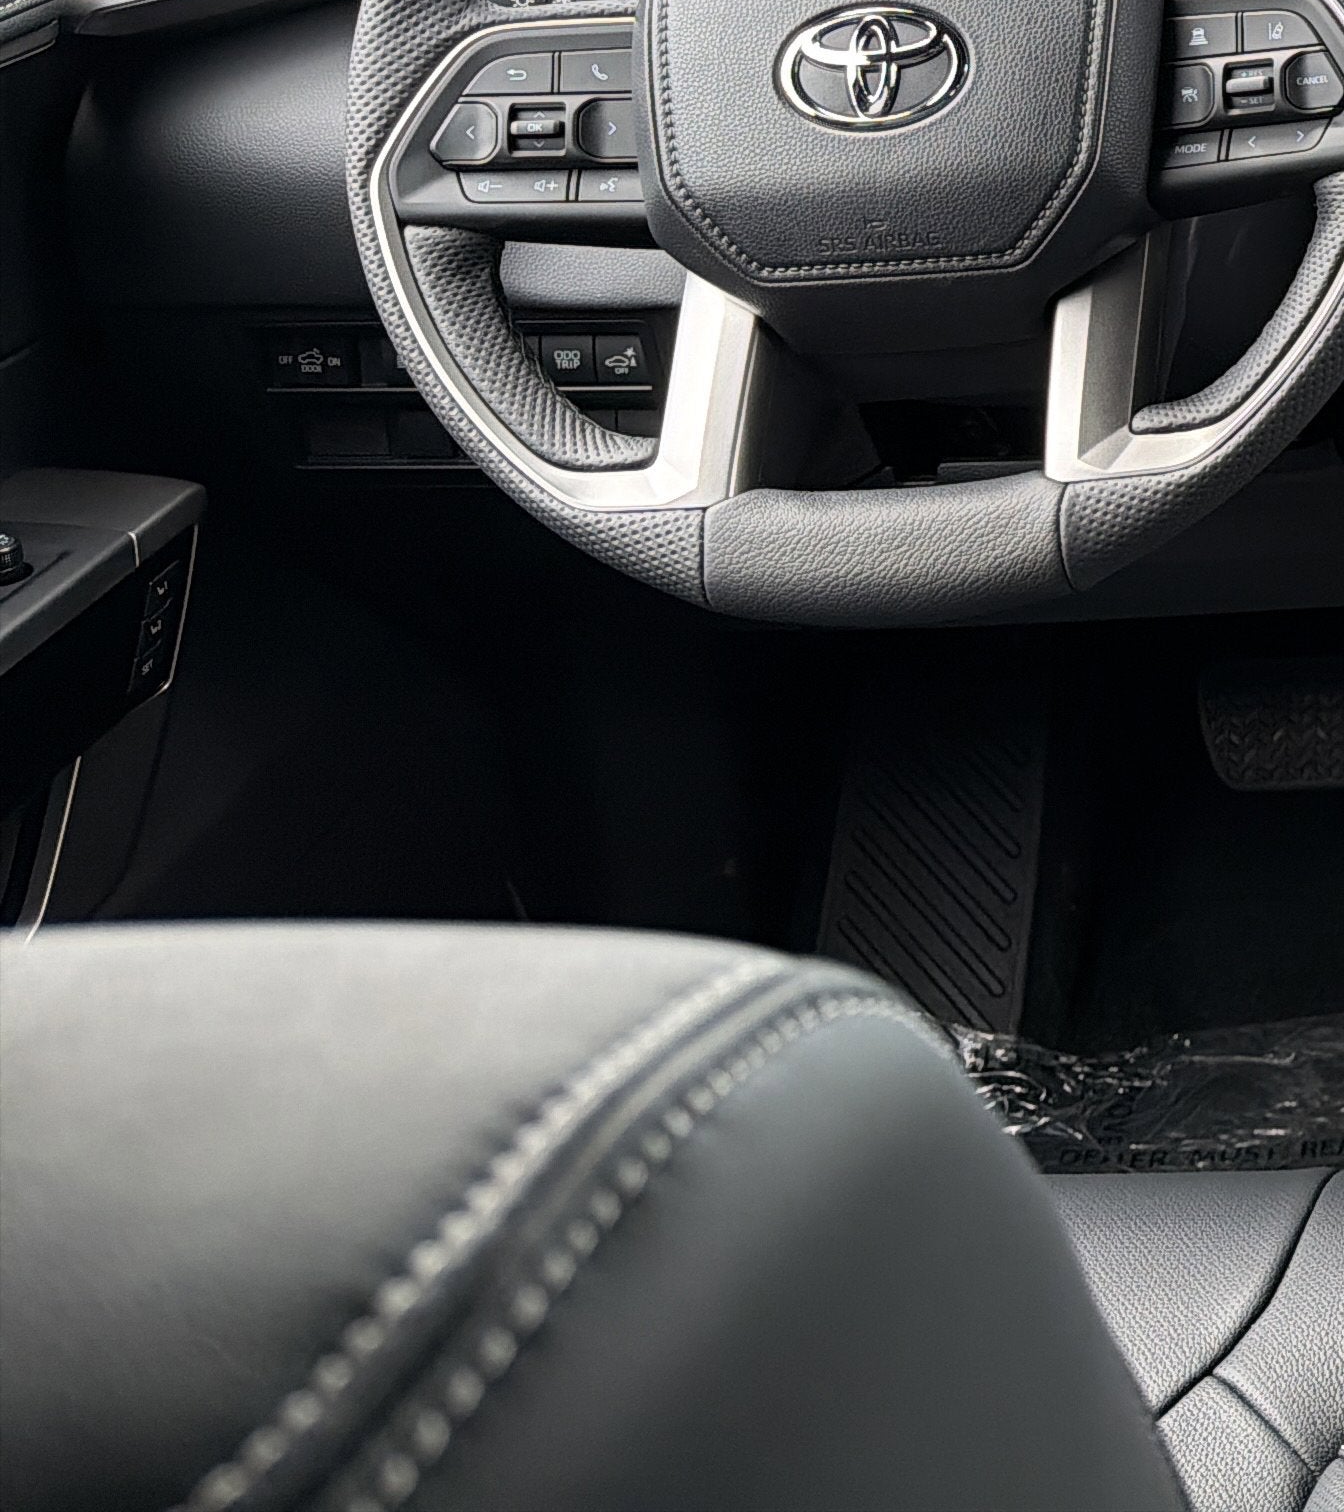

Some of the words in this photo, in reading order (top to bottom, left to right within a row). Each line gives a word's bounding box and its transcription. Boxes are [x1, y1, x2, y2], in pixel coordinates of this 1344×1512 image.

[1296, 75, 1329, 86] CANCEL
[527, 123, 543, 132] OK
[1174, 143, 1207, 154] MODE
[279, 355, 294, 364] OFF
[553, 350, 581, 360] ODO
[327, 357, 341, 366] ON
[555, 359, 581, 370] TRIP
[614, 367, 629, 375] OFF
